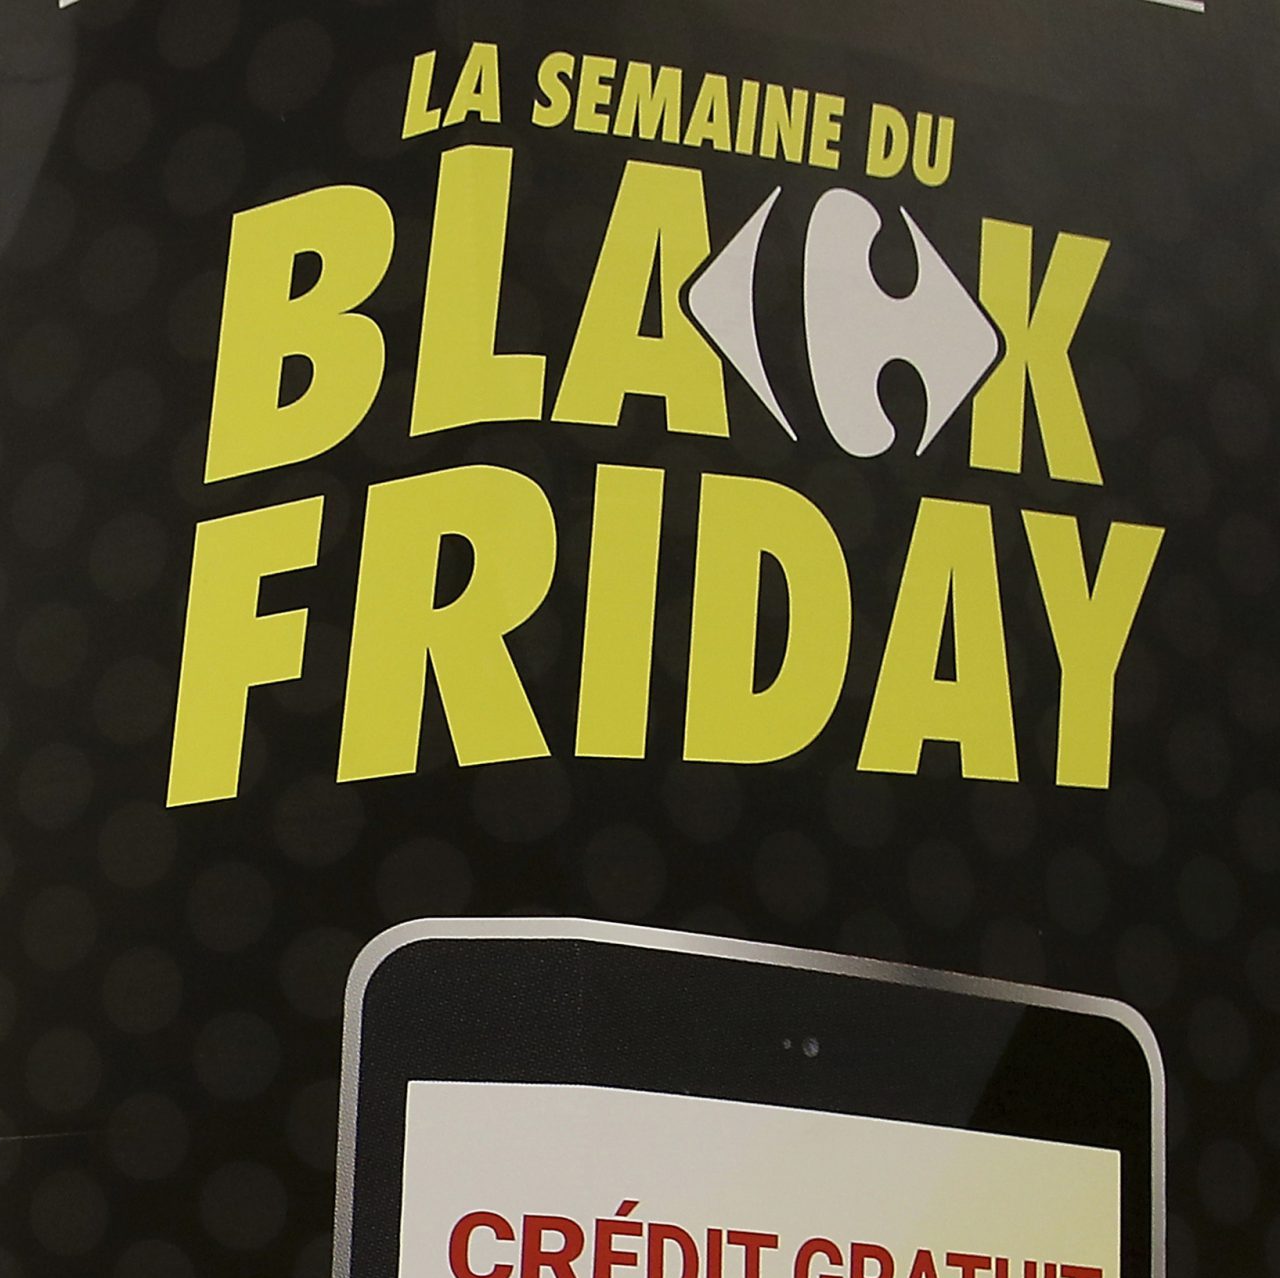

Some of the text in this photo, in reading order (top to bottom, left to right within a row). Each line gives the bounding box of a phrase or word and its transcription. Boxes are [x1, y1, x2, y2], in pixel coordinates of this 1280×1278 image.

[402, 42, 955, 187] LA SEMAINE DU
[166, 464, 1166, 807] FRIDAY
